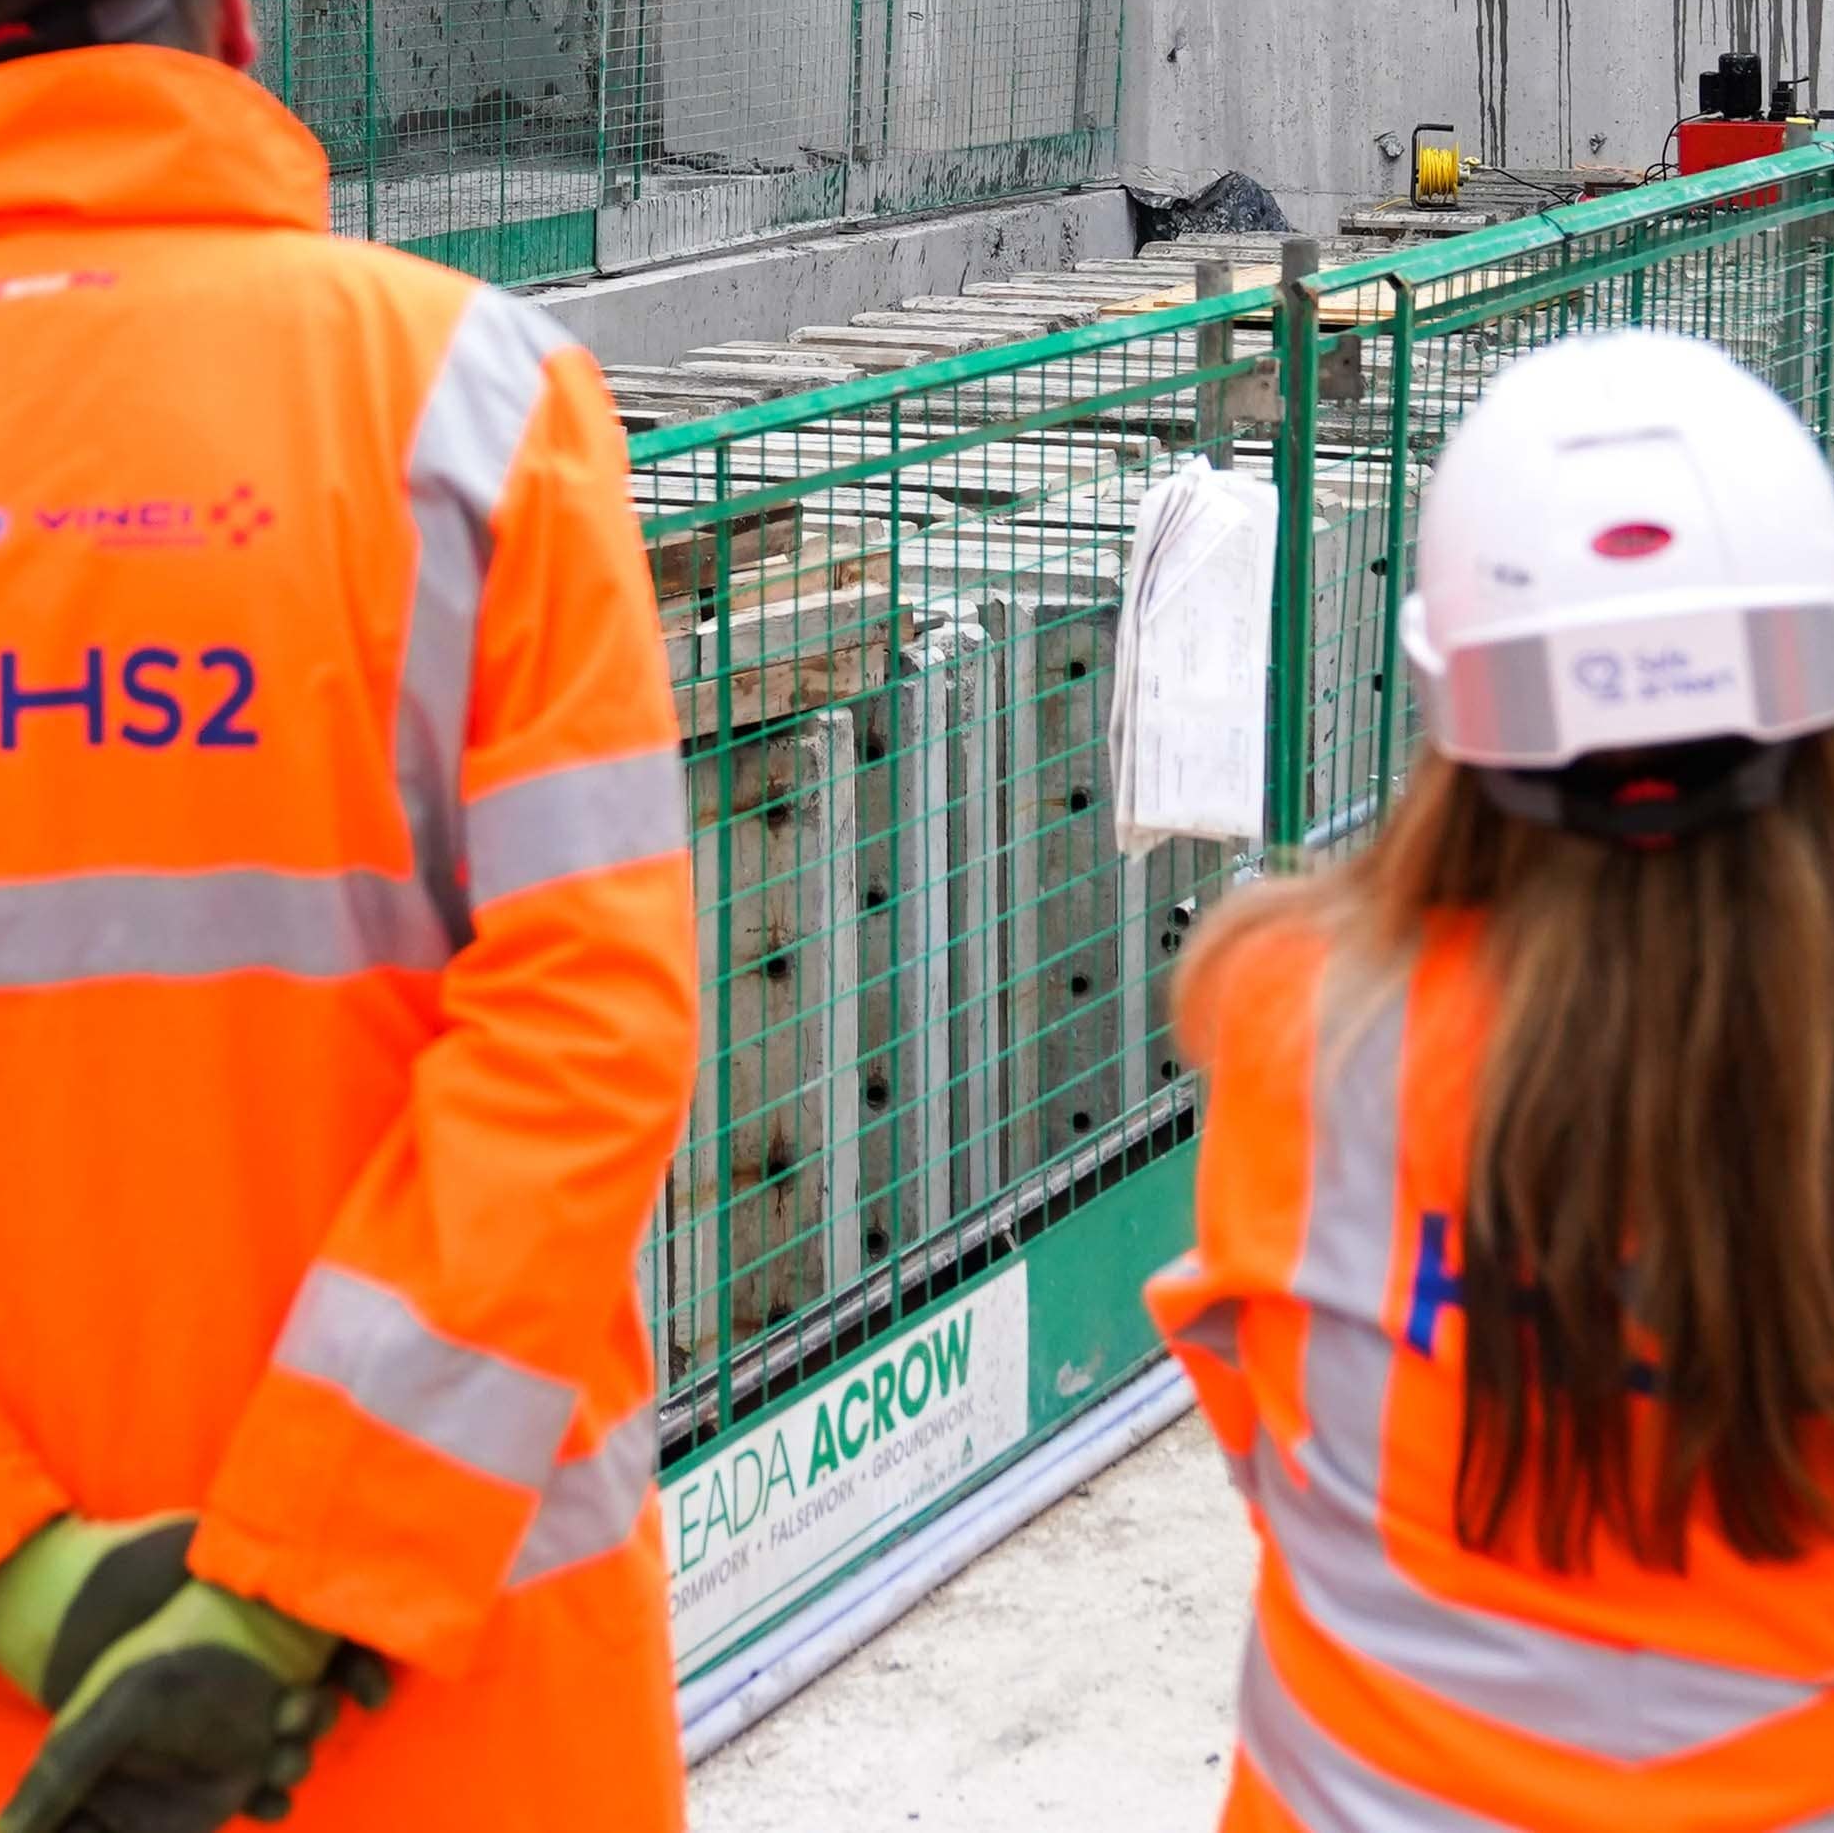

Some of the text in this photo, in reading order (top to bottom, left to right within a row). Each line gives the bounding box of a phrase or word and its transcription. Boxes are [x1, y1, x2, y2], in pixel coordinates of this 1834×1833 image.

[38, 503, 193, 531] VINCI
[0, 647, 259, 751] HS2
[669, 1540, 749, 1619] ORMWORK
[770, 1481, 856, 1550] FALSEWORK
[872, 1397, 974, 1478] GROUNDWORK
[670, 1308, 973, 1579] EADA ACROW
